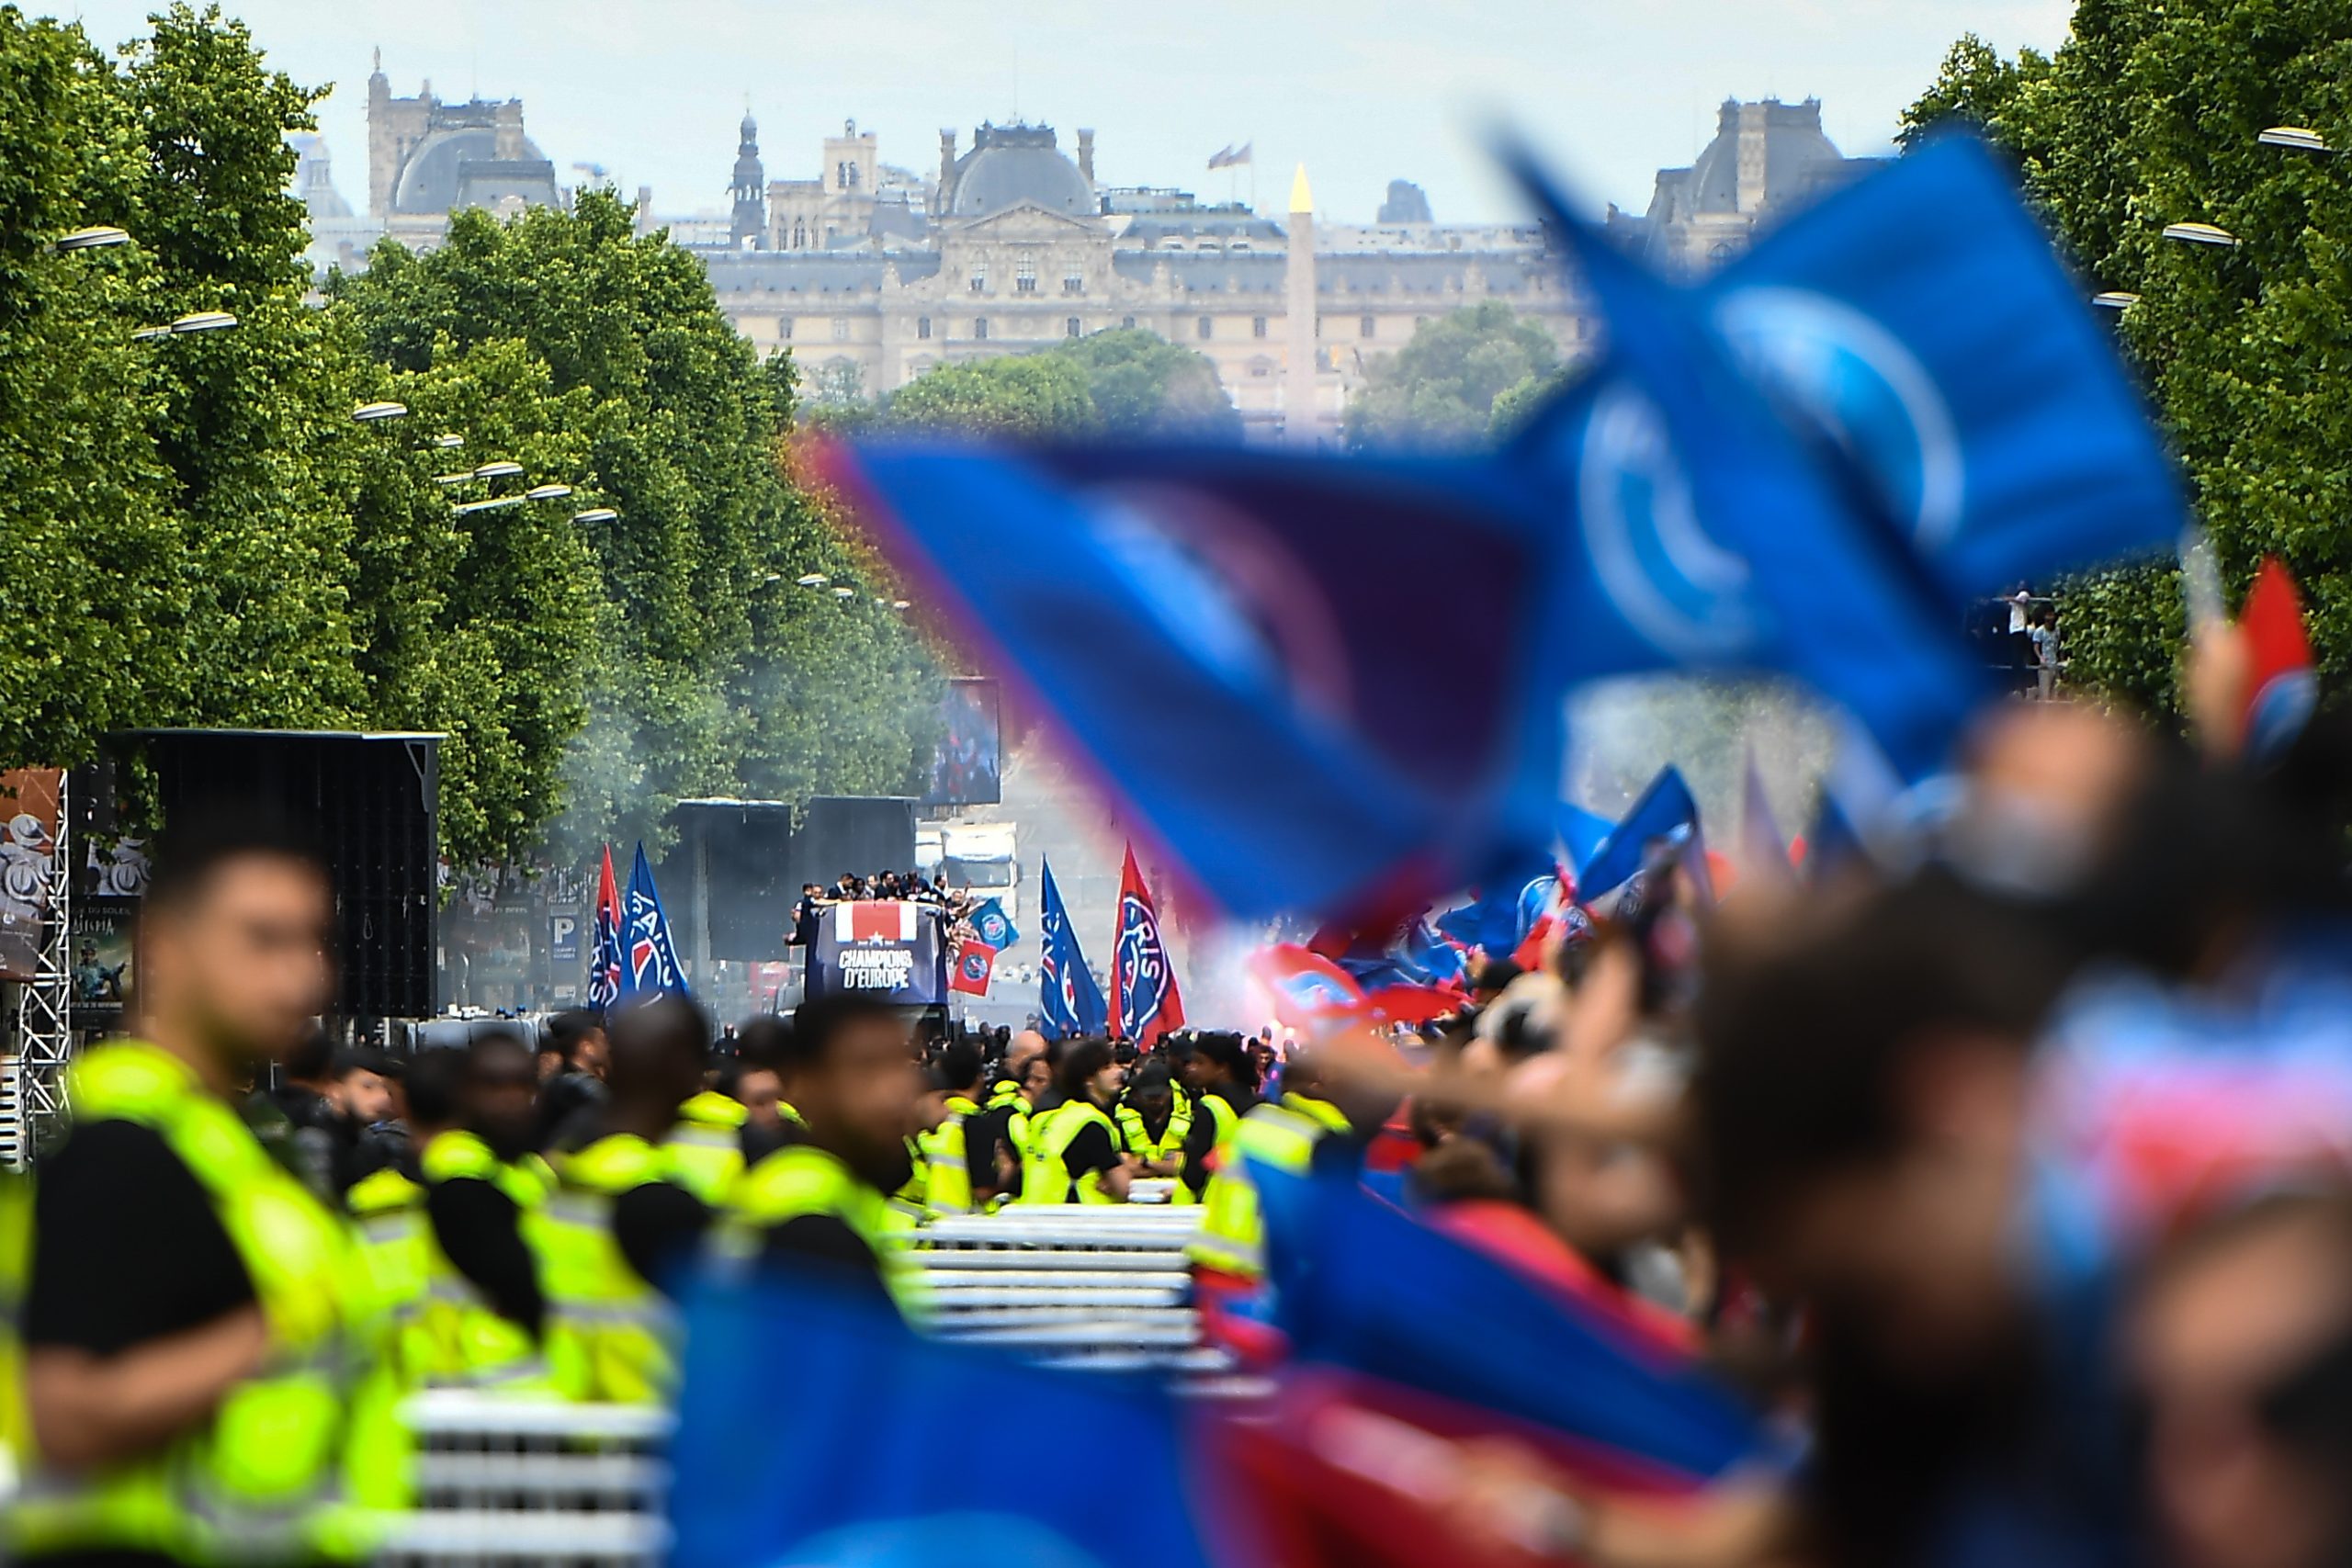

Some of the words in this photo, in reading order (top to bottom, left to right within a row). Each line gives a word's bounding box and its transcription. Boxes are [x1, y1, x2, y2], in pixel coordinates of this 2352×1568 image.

[554, 917, 575, 943] P
[840, 949, 912, 970] CHAMPIONS
[844, 968, 910, 989] D'EUROPE
